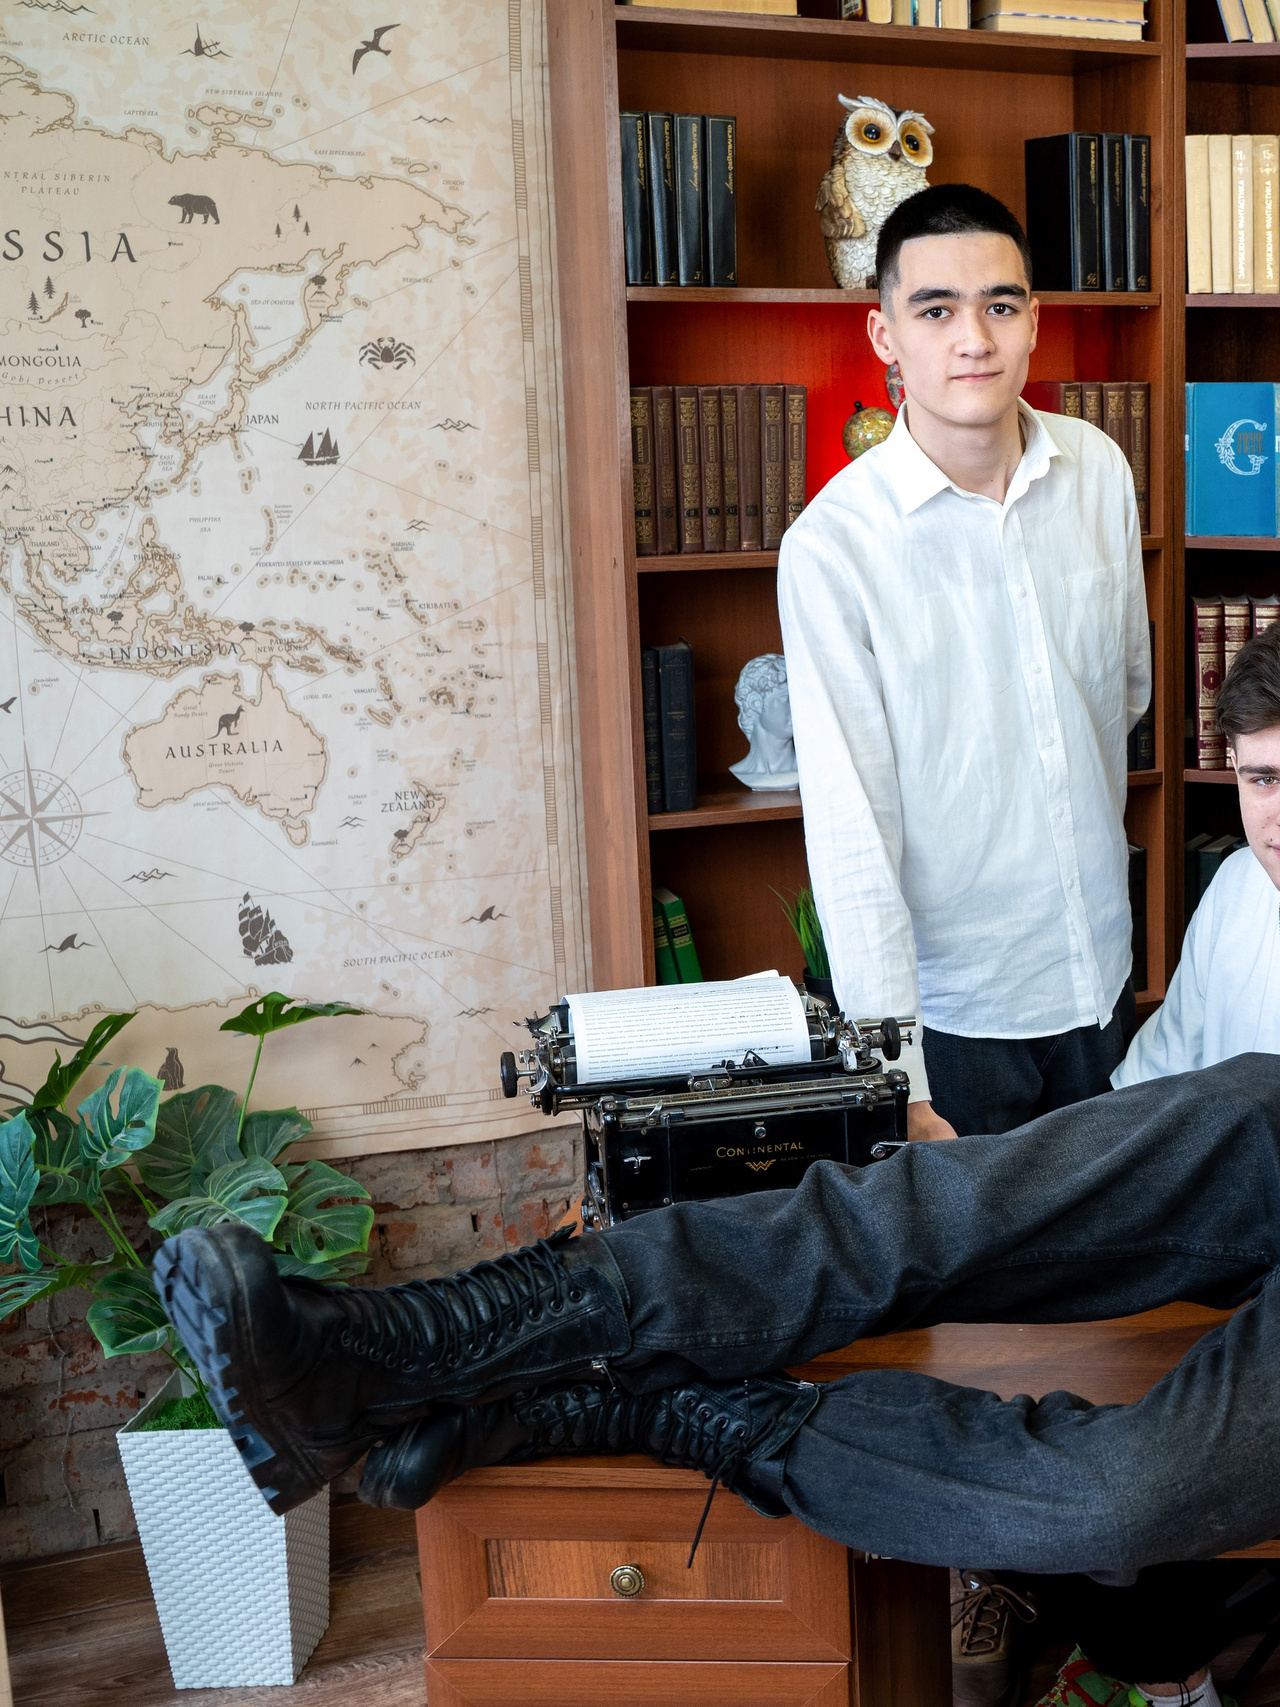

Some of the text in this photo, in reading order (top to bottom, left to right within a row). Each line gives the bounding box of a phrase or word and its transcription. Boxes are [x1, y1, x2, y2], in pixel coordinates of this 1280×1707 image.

[62, 32, 150, 46] ARCTIC OCEAN
[54, 173, 111, 183] SIBERIN
[21, 186, 80, 196] PLATEAU
[1237, 179, 1246, 280] ЗАРУБЕЖНАЯ ФАНТАСТИКА
[1264, 180, 1274, 280] ЗАРУБЕЖНАЯ ФАНТАСТИКА
[2, 229, 138, 263] SSIA
[2, 371, 79, 386] Gobi Desert
[305, 401, 422, 411] NORTH PACIFIC OCEAN
[245, 414, 280, 427] JAPAN
[39, 514, 60, 522] LAOS
[133, 552, 182, 562] PHILIPPINES
[418, 602, 451, 611] KIRIBATI
[109, 641, 239, 661] INDONESIA
[165, 739, 284, 760] AUSTRALIA
[394, 791, 420, 801] NEW
[381, 800, 436, 813] ZEALAND
[343, 949, 455, 969] SOUTH PACIFIC OCEAN
